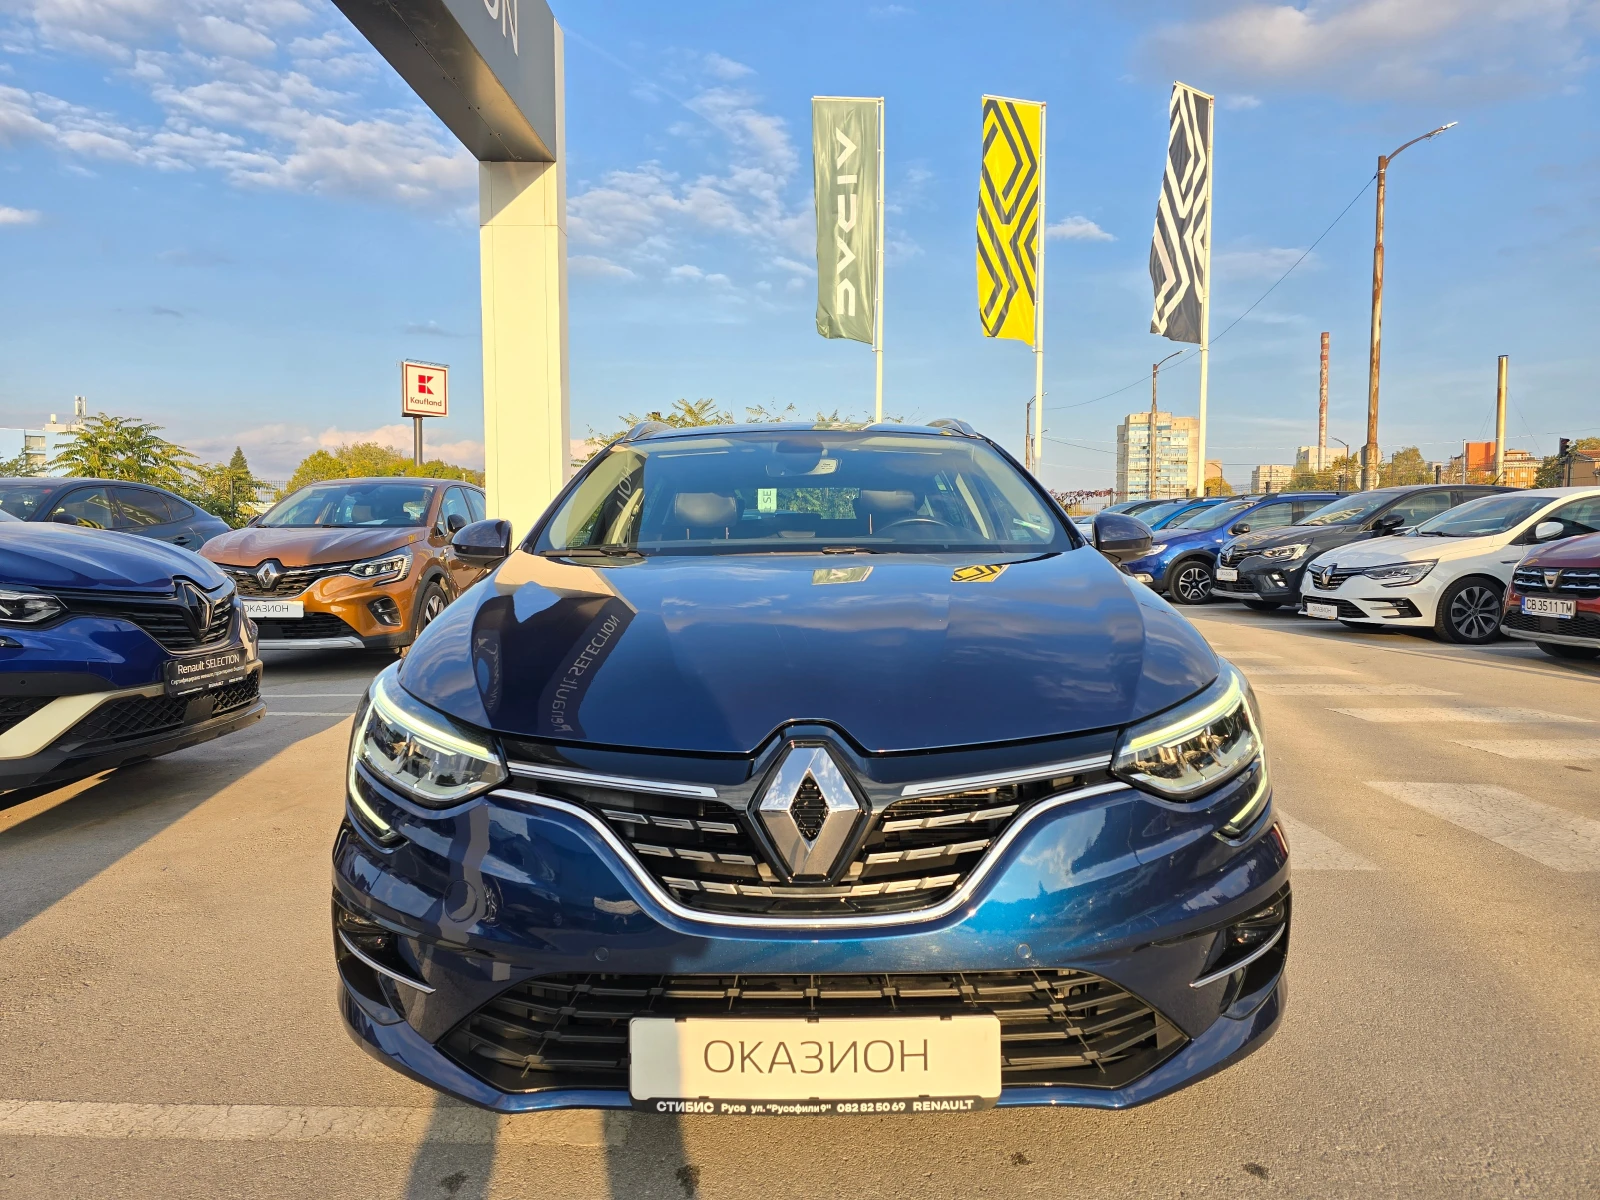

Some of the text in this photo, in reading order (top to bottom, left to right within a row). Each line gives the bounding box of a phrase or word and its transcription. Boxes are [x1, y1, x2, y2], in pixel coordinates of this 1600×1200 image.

[409, 396, 443, 407] Kaufland
[1538, 599, 1558, 613] 3511
[177, 660, 205, 675] Renault
[205, 653, 240, 670] SELECTION
[703, 1038, 929, 1075] ОКАЗИОН
[656, 1101, 715, 1113] СТИБИС
[720, 1103, 747, 1114] Русе
[912, 1099, 975, 1111] RENAULT
